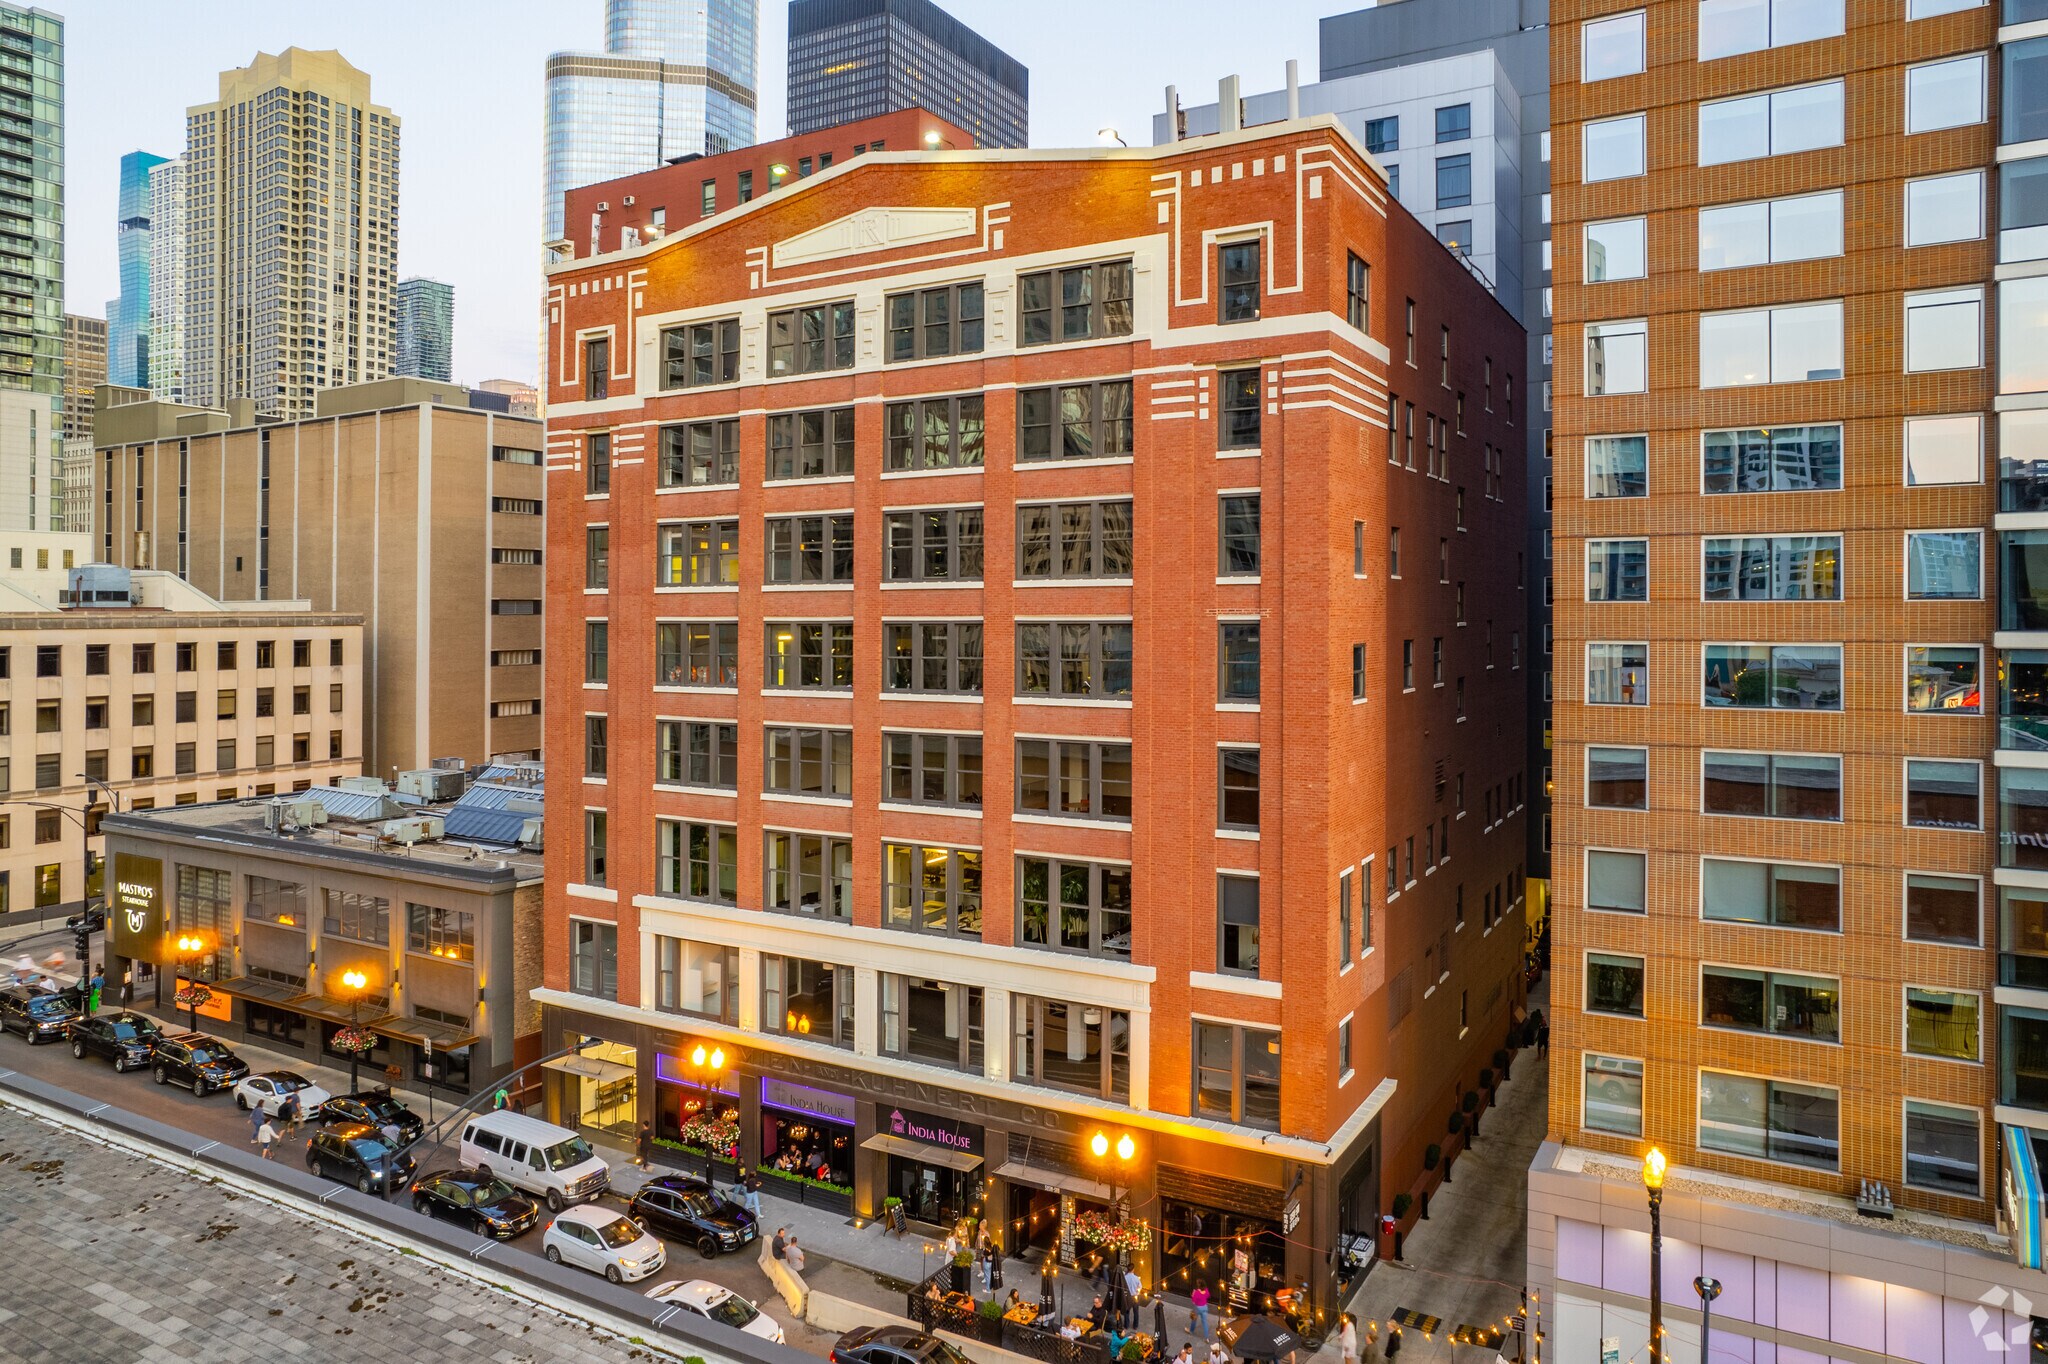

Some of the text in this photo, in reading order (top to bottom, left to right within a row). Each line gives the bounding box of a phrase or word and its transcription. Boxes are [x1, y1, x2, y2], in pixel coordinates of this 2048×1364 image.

[118, 882, 153, 898] MASTRO'S
[790, 1094, 845, 1118] INDIA HOUSE
[908, 1122, 971, 1149] INDIA HOUSE
